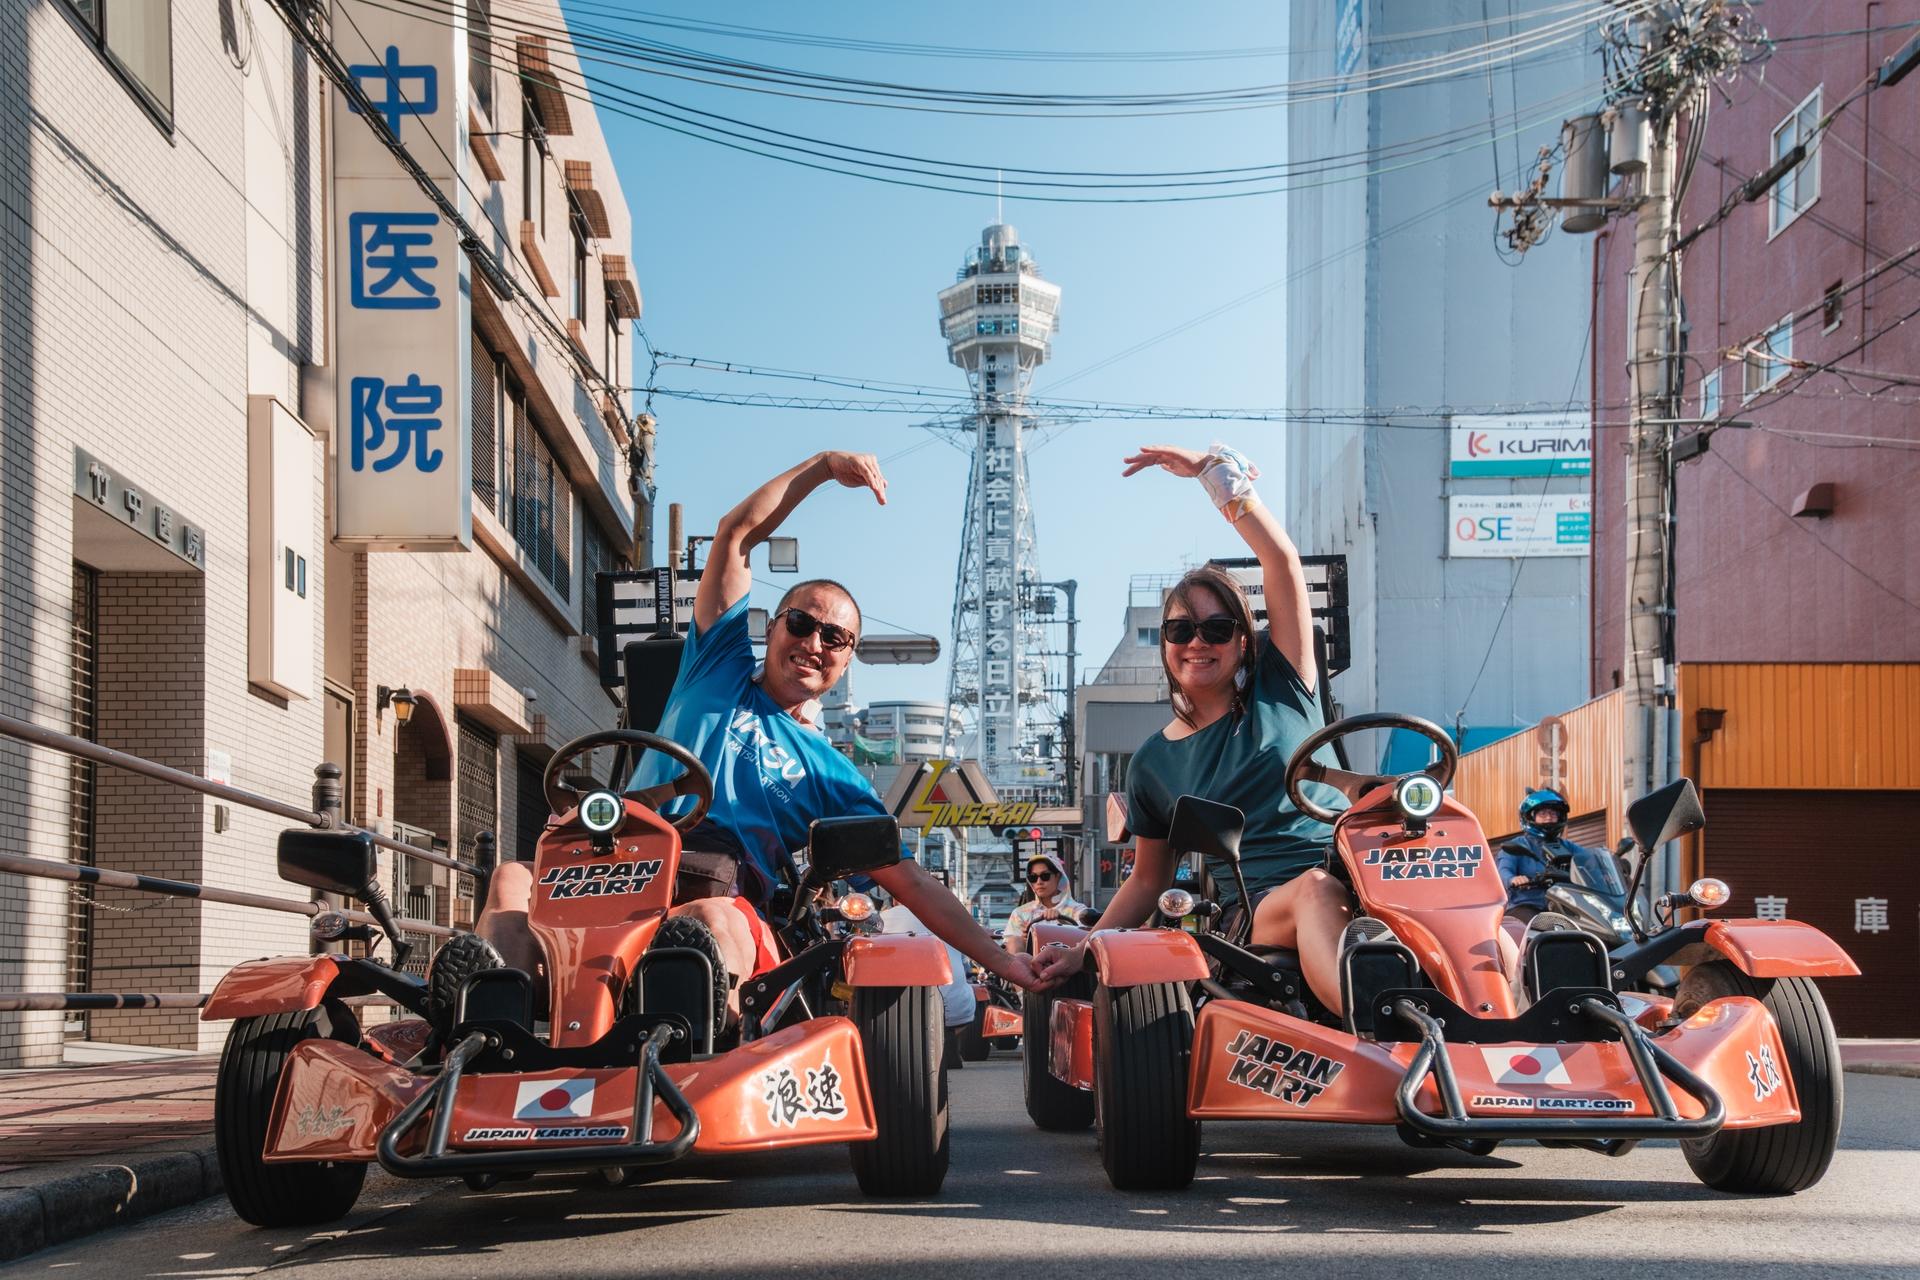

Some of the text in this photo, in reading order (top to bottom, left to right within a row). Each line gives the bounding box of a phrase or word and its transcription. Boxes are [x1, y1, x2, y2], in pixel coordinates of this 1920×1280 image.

[348, 45, 443, 473] 中医院
[1456, 516, 1513, 541] QSE
[984, 447, 1011, 717] 社会に貢献する日立
[1364, 846, 1482, 865] JAPAN
[539, 859, 663, 884] JAPAN
[1381, 862, 1479, 880] KART
[549, 876, 653, 900] KART
[1755, 895, 1920, 934] 車庫
[1226, 1029, 1345, 1087] JAPAN
[765, 1064, 844, 1124] 浪速
[1227, 1057, 1325, 1108] KART
[1473, 1096, 1633, 1109] JAPAN KART.com
[466, 1127, 627, 1140] JAPAN KART.com
